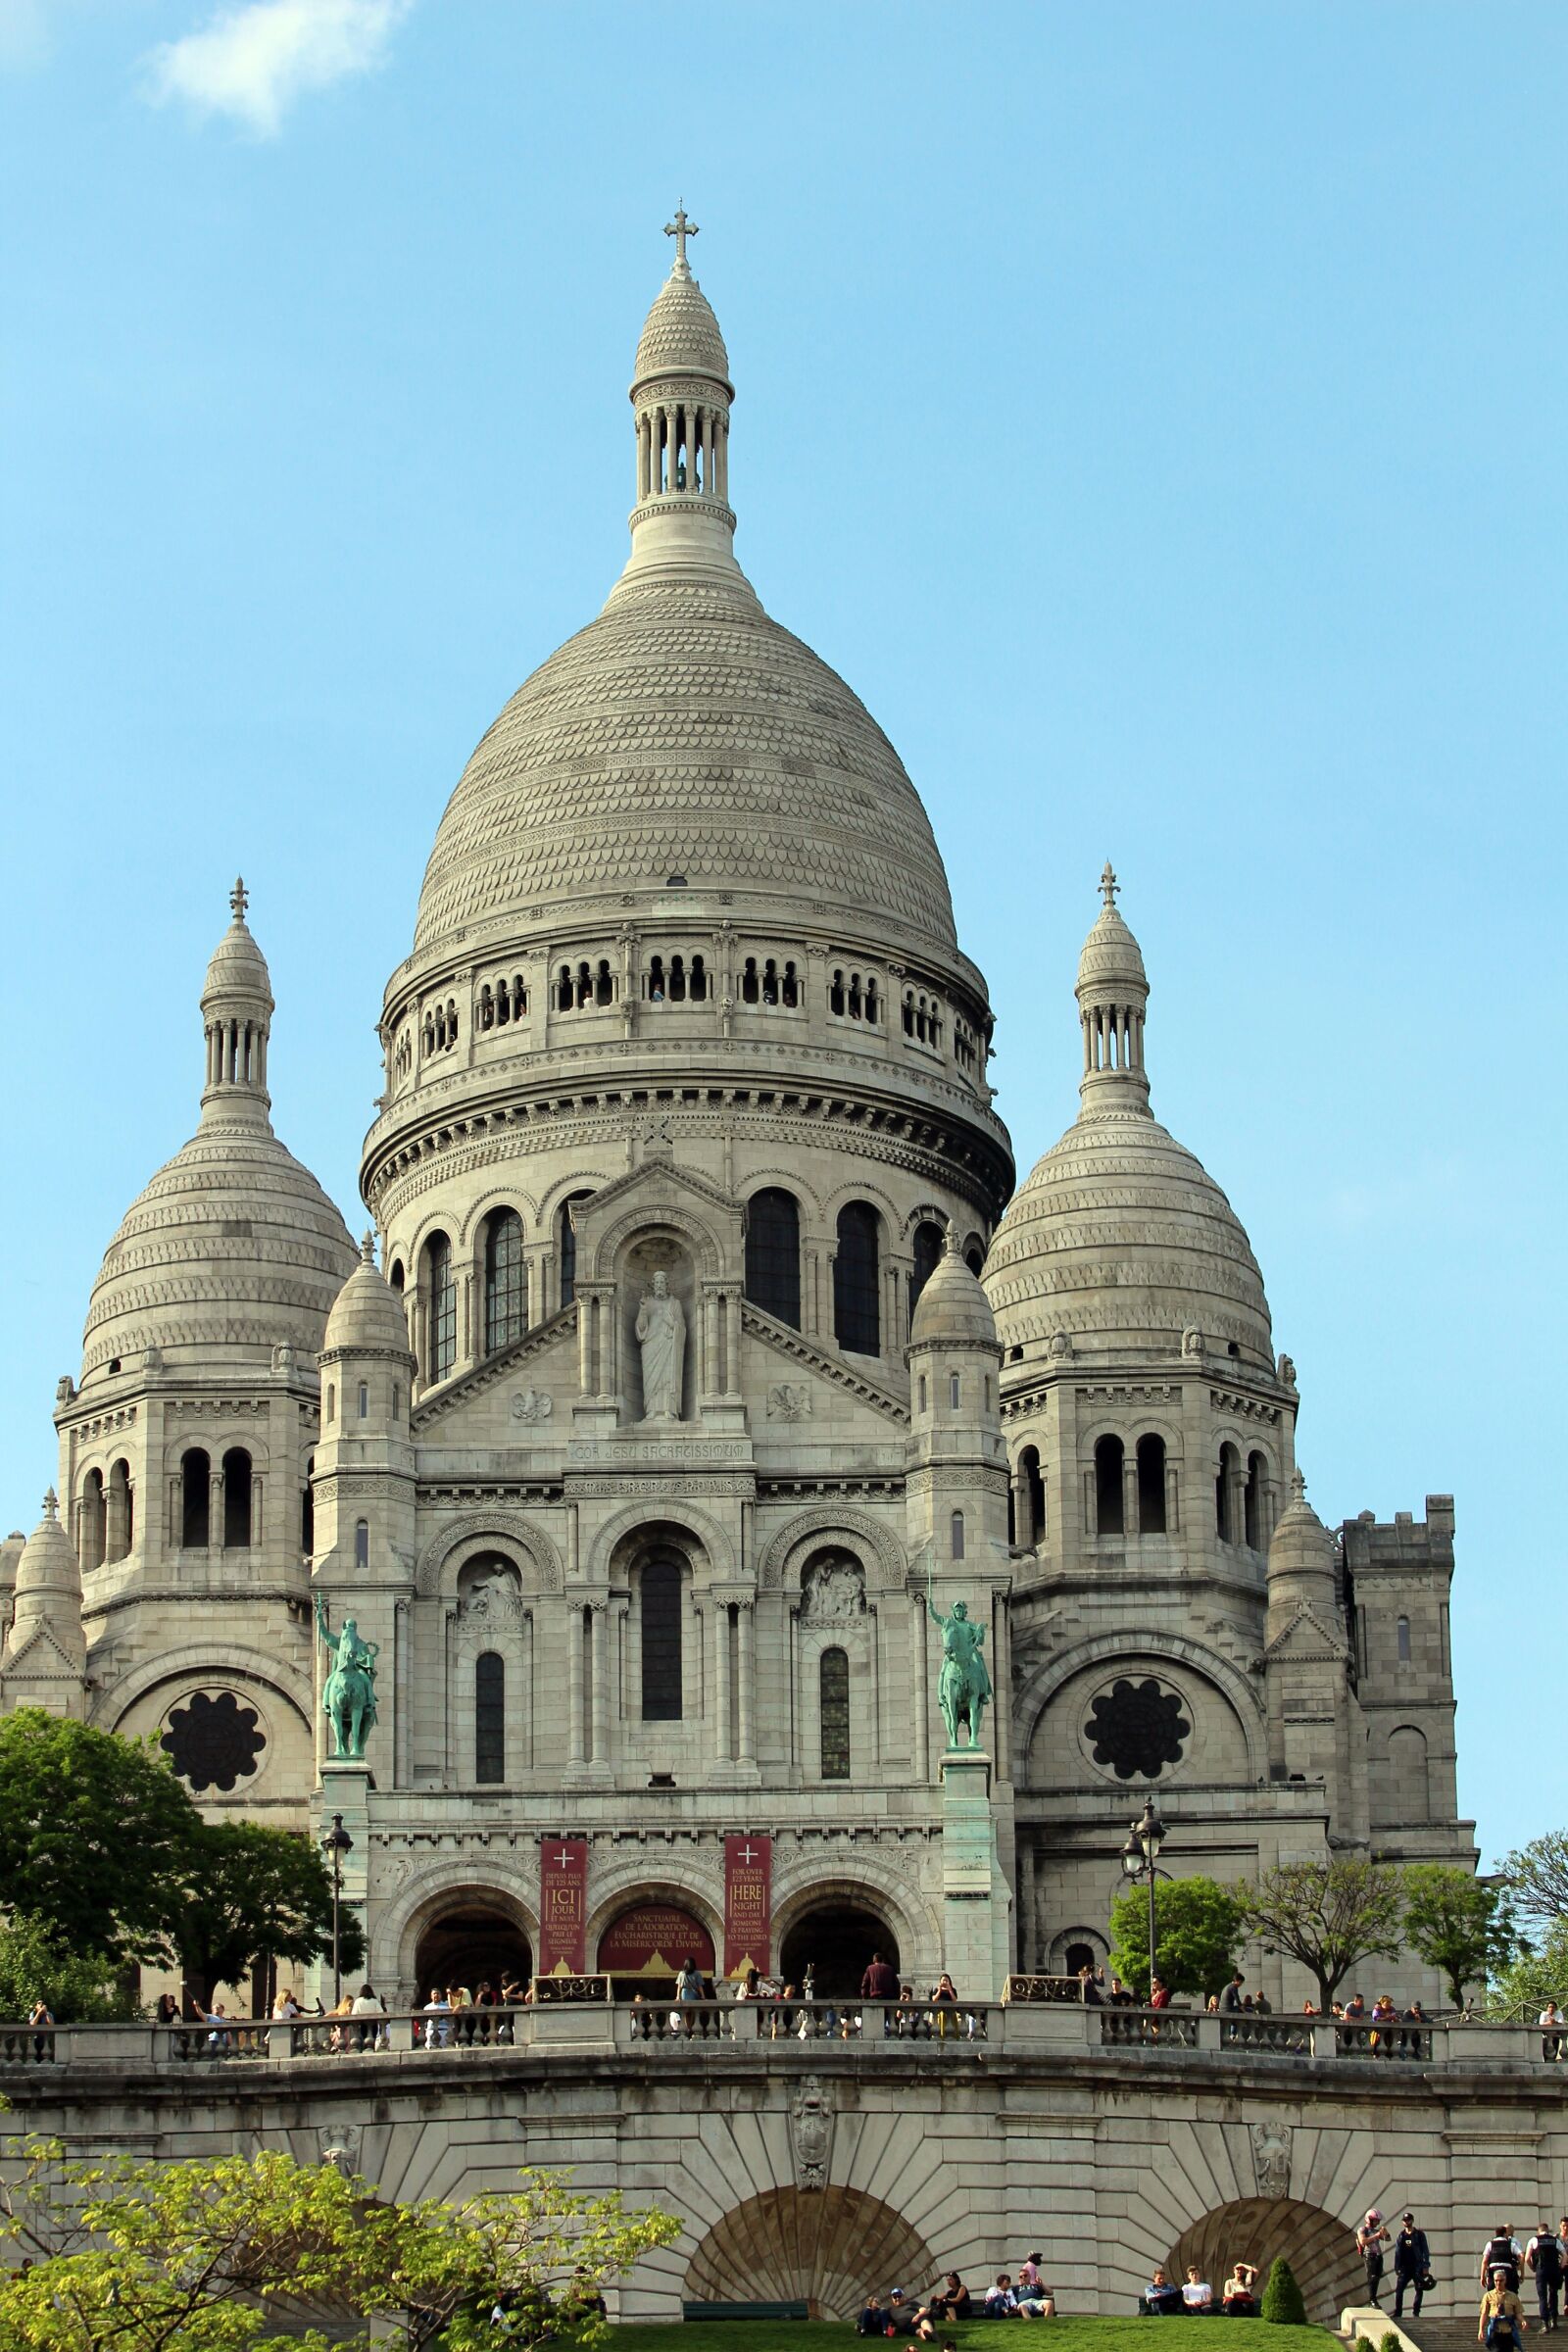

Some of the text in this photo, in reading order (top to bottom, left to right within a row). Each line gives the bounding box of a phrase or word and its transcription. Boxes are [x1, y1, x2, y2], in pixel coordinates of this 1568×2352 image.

[575, 1446, 743, 1458] COR JESU SACRATISSIMUM
[552, 1889, 574, 1904] ICI
[733, 1885, 761, 1900] HERE
[551, 1905, 576, 1915] JOUR
[733, 1901, 760, 1910] NIGHT
[633, 1914, 680, 1924] SANCTUAIRE
[614, 1931, 675, 1939] EUCHARISTIQUE
[675, 1938, 703, 1948] DIVINE
